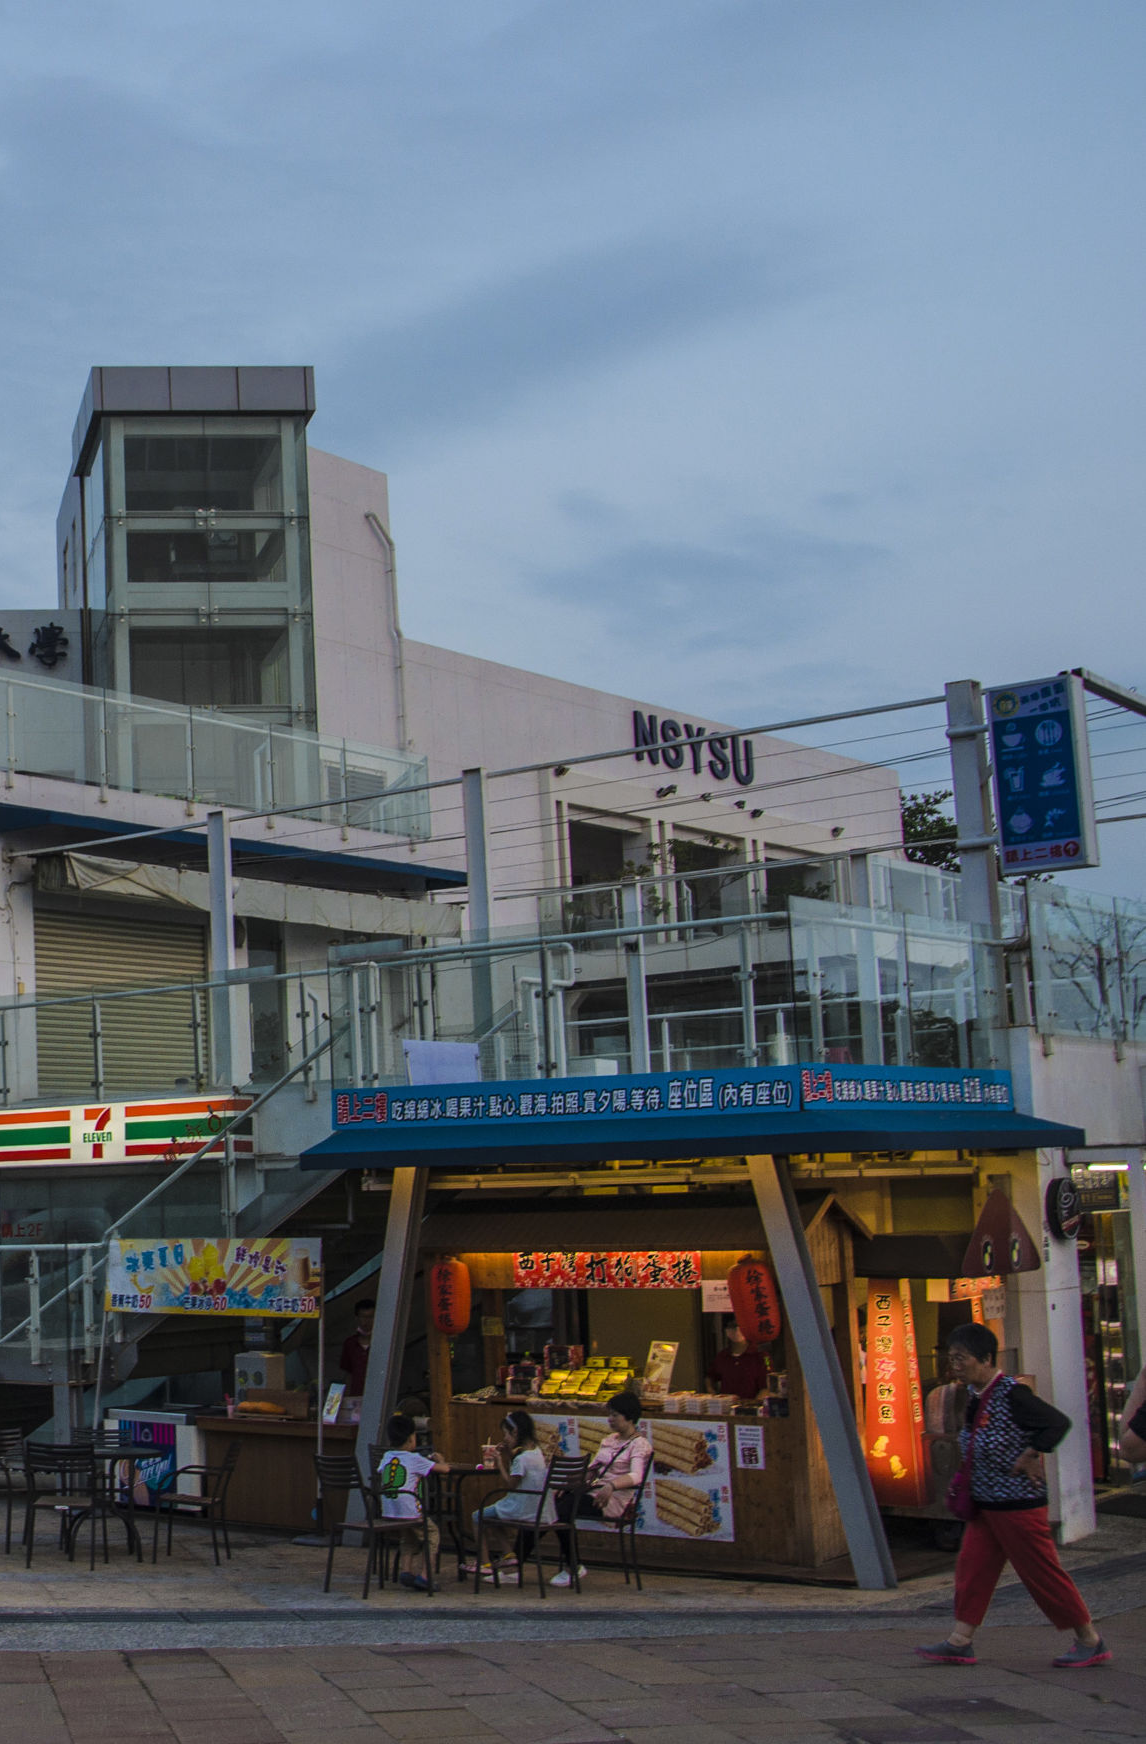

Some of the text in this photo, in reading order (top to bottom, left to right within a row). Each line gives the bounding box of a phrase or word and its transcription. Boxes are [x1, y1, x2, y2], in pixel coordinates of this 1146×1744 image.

[632, 710, 754, 786] NSYSU
[668, 1078, 714, 1109] 座位區
